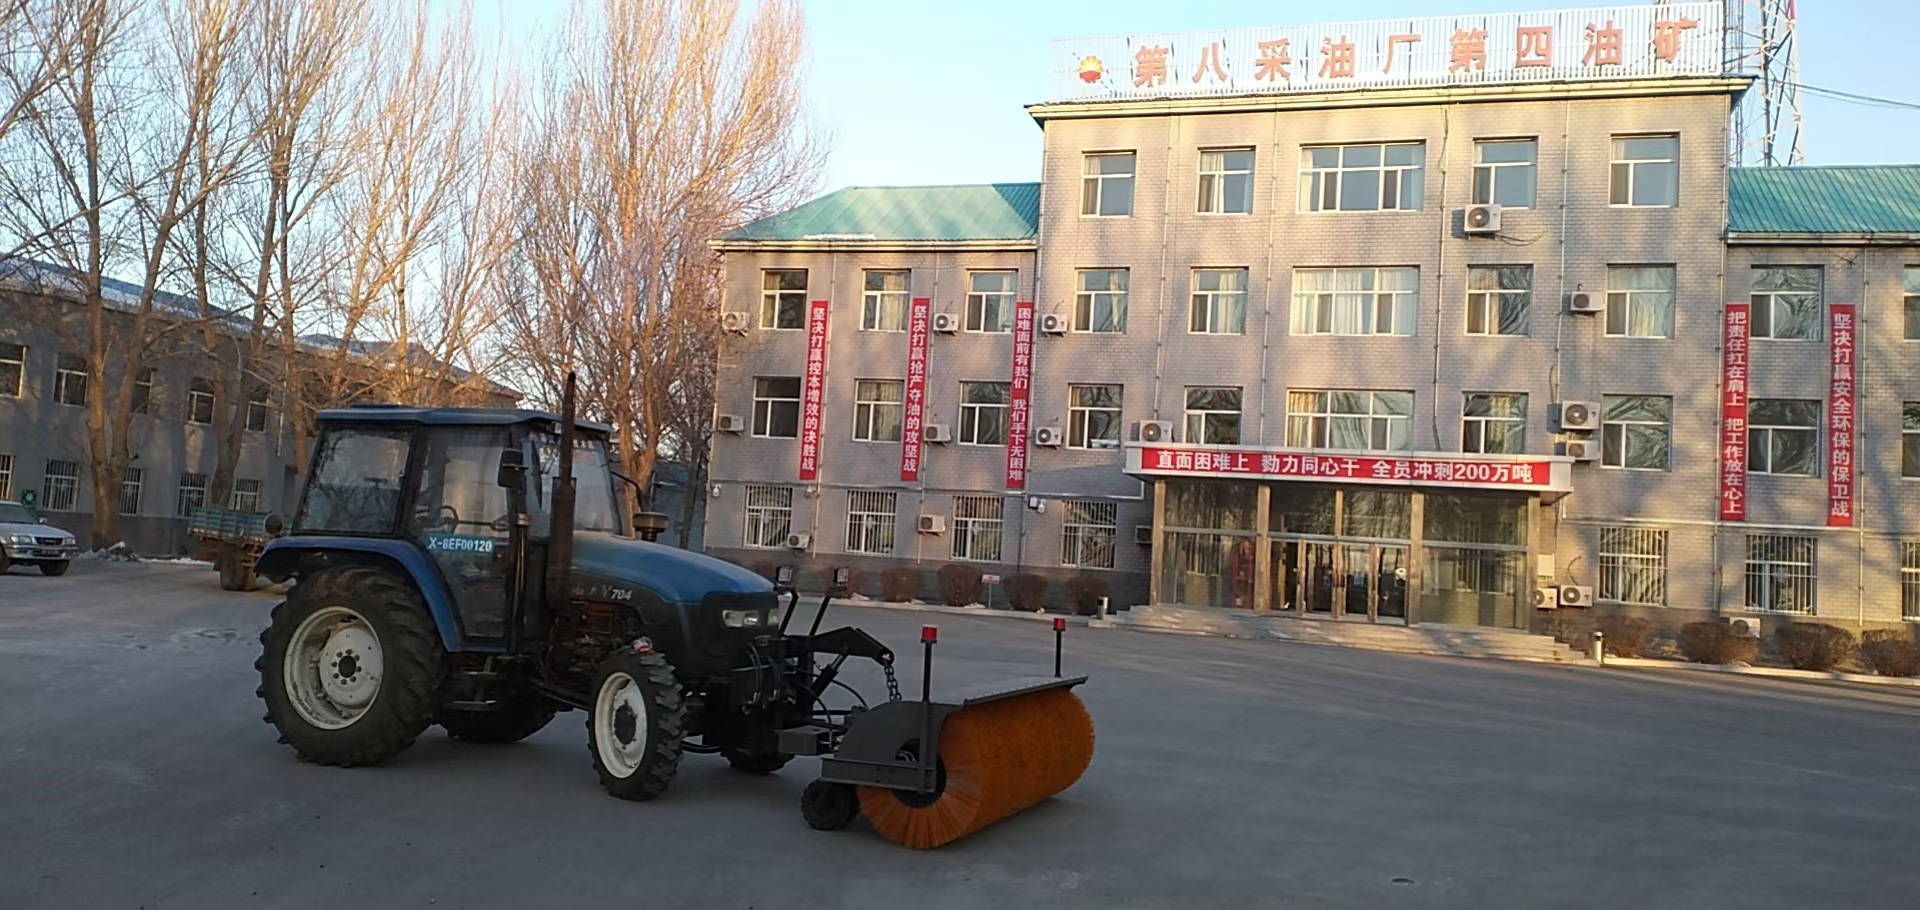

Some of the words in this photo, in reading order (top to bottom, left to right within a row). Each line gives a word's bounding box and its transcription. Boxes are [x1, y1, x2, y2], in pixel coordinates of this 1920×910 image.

[1131, 17, 1699, 88] 第八采油厂第四油矿
[801, 306, 827, 472] 坚决打赢控本增效的决胜战
[903, 305, 928, 473] 坚决打赢抢产夺油的攻坚战
[1013, 307, 1032, 390] 困难面前有我们
[1726, 311, 1747, 407] 把责任扛在肩上
[1009, 399, 1028, 481] 我们手下无困难
[1832, 313, 1852, 518] 坚决打赢安全环保的保卫战
[1156, 450, 1250, 472] 直面困难上
[1371, 459, 1534, 483] 全员冲刺200万吨
[1724, 418, 1745, 514] 把工作放在心上
[428, 537, 492, 552] X-8EF00120
[611, 589, 633, 601] 704
